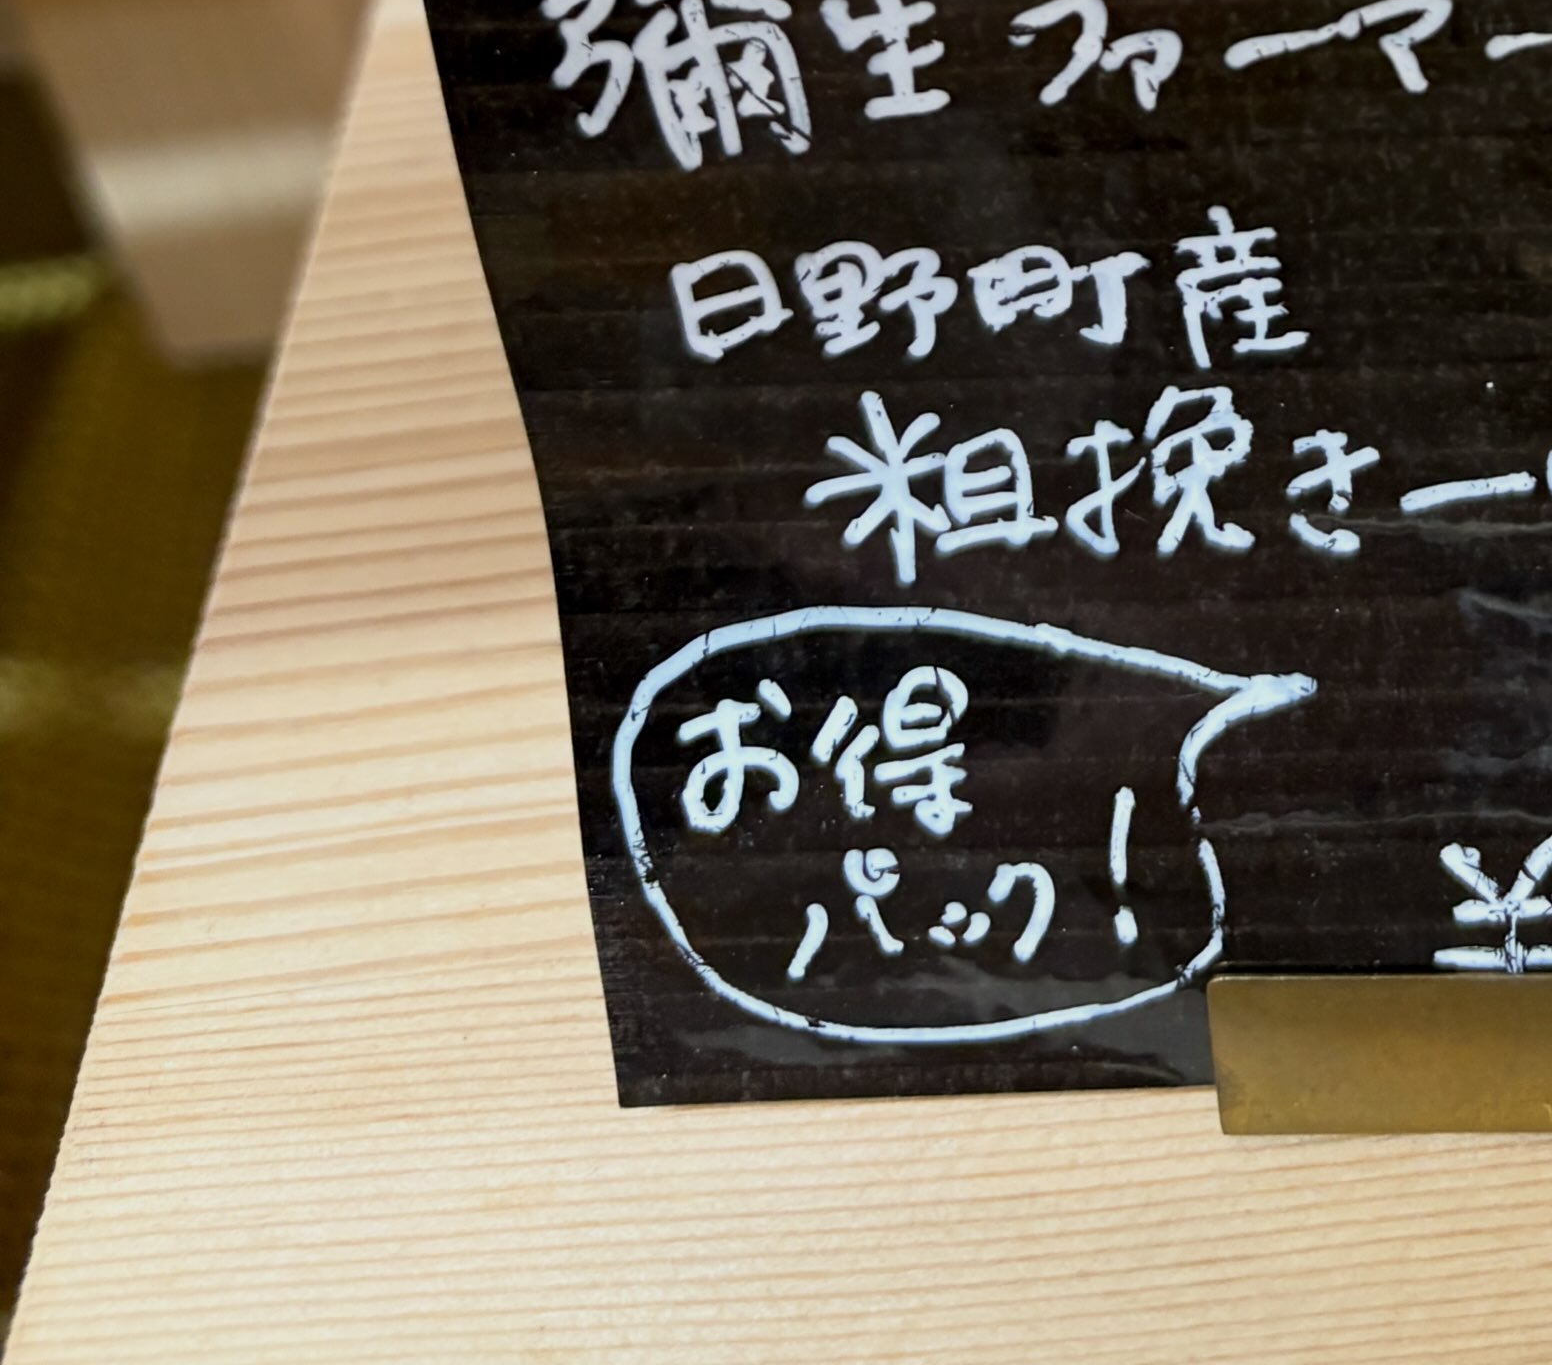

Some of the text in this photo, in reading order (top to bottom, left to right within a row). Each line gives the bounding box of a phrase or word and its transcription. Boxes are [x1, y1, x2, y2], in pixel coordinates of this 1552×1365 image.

[670, 206, 1309, 369] 日野町産
[676, 665, 974, 835] お得
